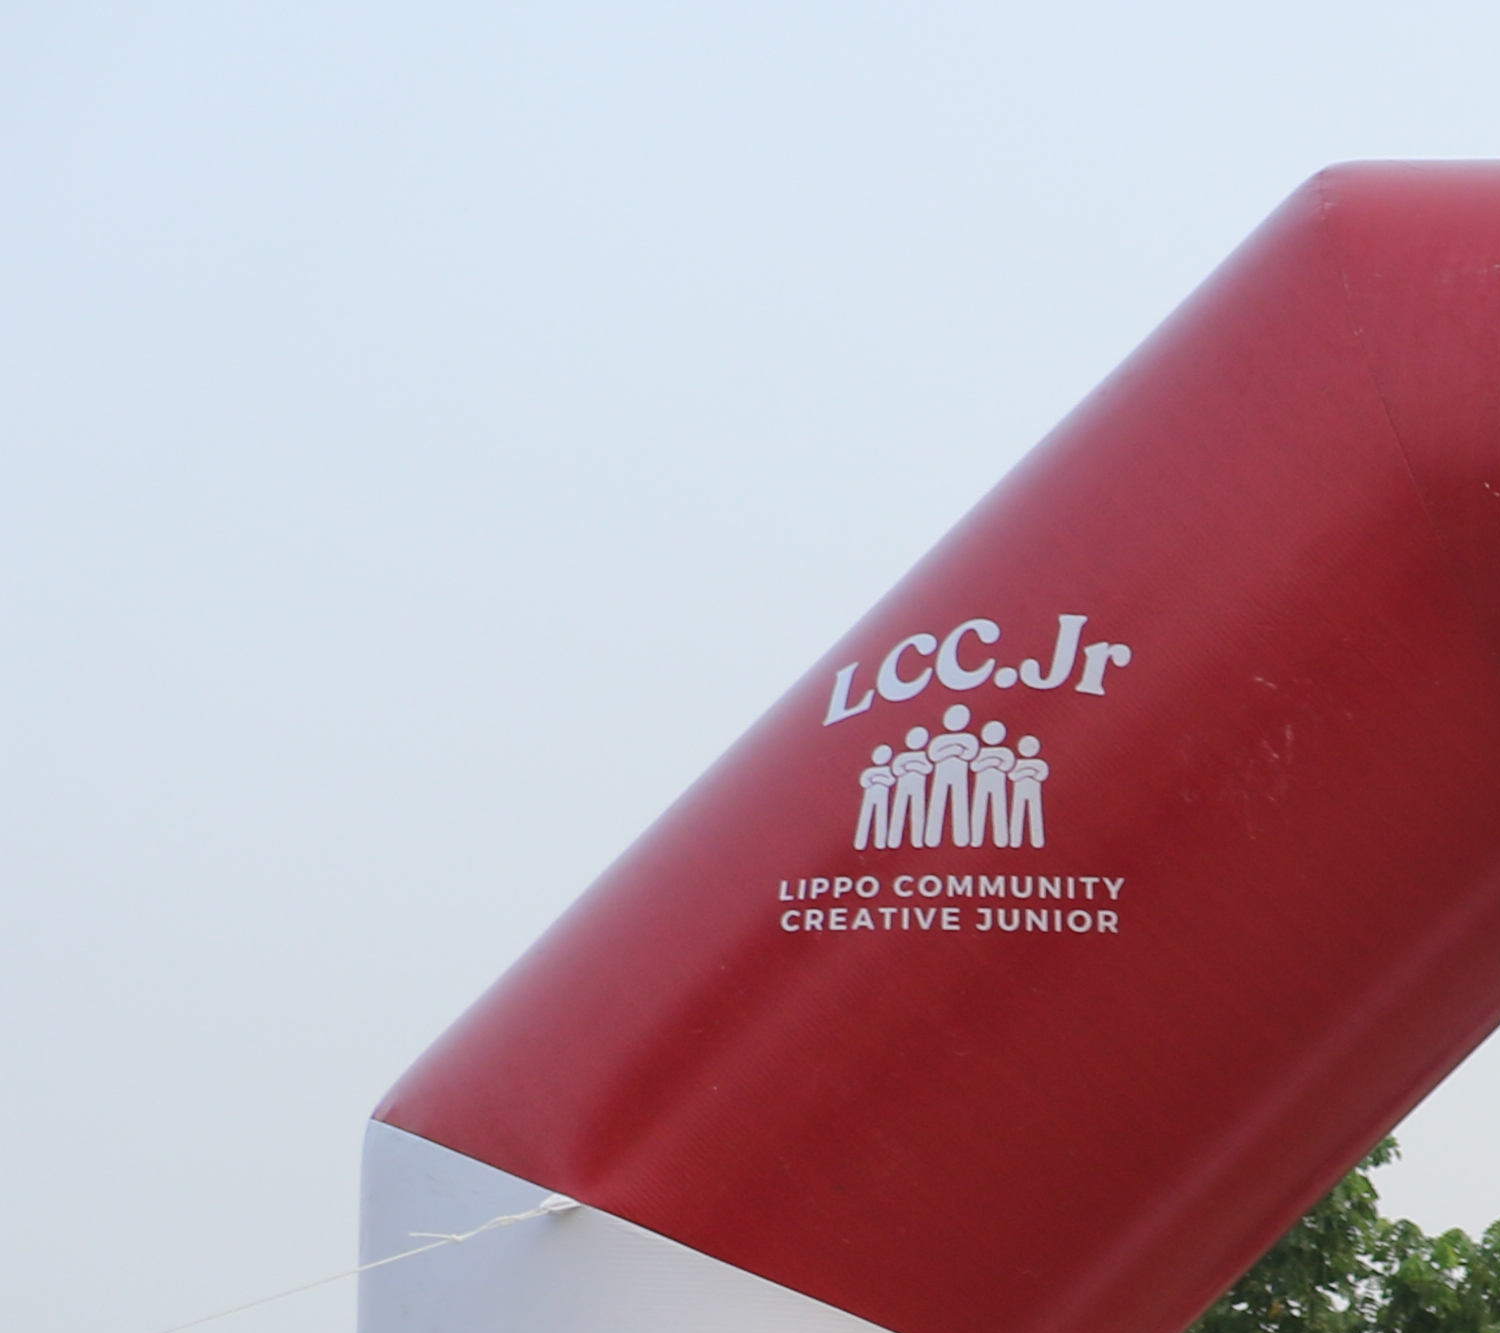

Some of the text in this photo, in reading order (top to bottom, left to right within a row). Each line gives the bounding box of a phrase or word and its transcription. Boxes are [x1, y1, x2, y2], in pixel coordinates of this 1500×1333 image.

[822, 613, 1132, 726] LCC.Jr
[778, 875, 1125, 901] LIPPO COMMUNITY
[780, 907, 1120, 933] CREATIVE JUNIOR
